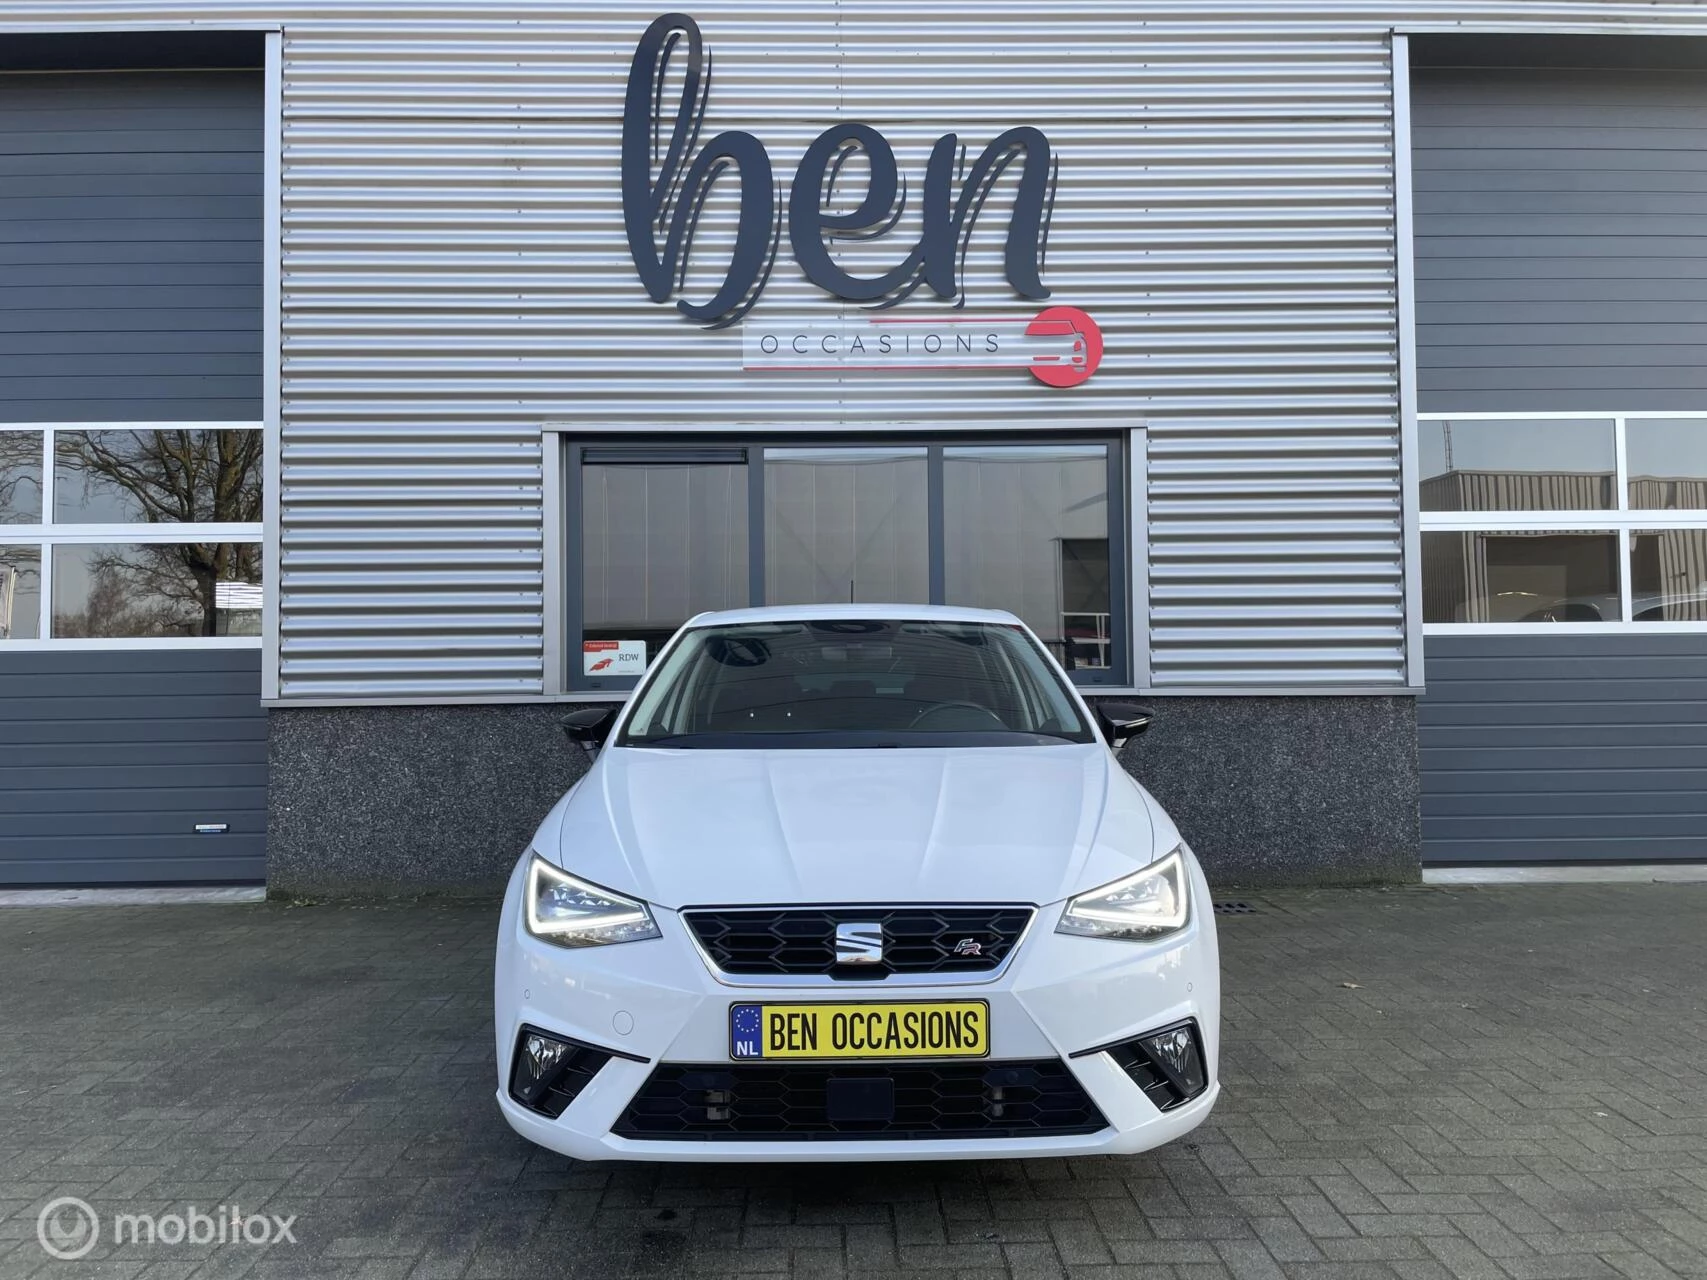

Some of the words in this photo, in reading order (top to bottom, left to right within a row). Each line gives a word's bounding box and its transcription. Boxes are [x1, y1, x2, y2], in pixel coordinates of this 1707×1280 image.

[621, 12, 1058, 330] ben
[760, 333, 1000, 355] OCCASIONS
[618, 653, 638, 662] RDW
[770, 1013, 817, 1050] BEN
[832, 1011, 978, 1049] OCCASIONS
[736, 1041, 759, 1056] NL
